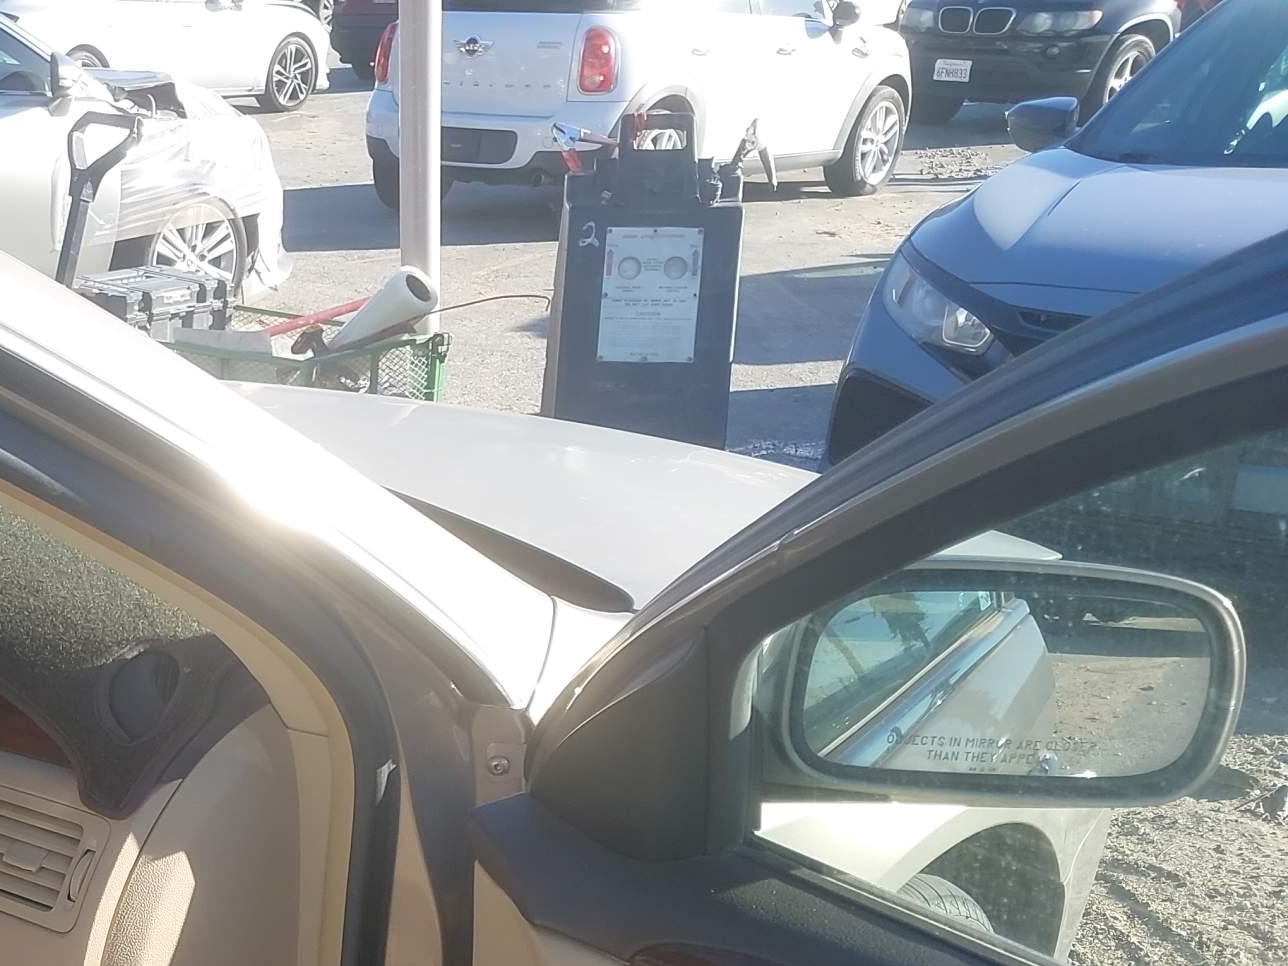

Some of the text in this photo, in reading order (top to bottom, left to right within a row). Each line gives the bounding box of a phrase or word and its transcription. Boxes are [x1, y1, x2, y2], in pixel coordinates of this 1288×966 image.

[578, 220, 599, 248] 2
[948, 735, 962, 747] IN
[965, 737, 1012, 749] MIRROR
[1016, 739, 1040, 751] ARE
[927, 750, 1047, 764] THAN THEY APPE
